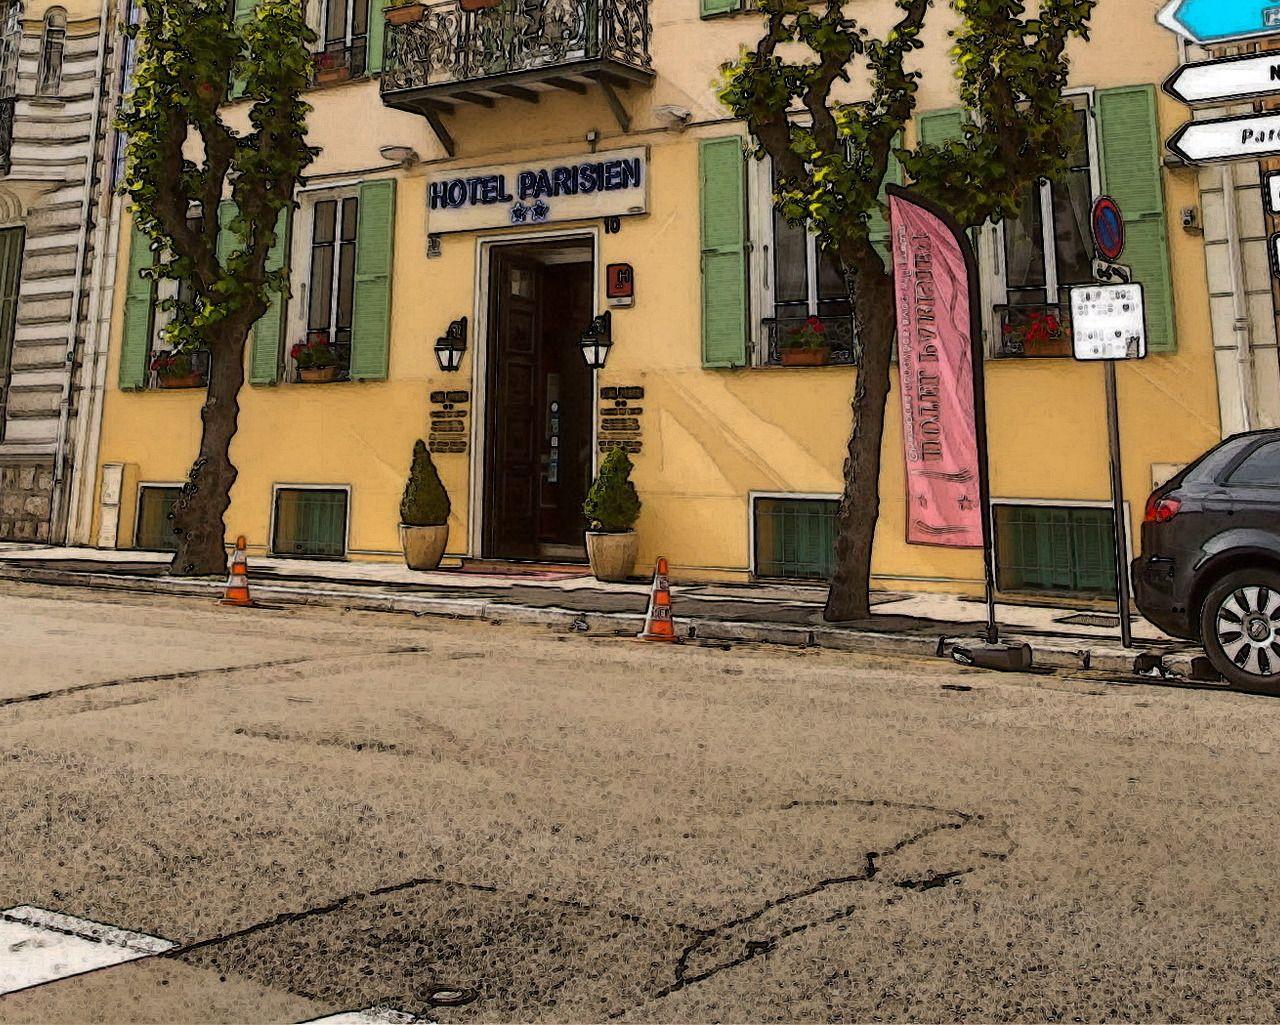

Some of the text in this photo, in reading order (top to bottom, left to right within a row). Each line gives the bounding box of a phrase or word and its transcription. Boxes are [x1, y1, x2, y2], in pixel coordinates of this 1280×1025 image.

[428, 157, 641, 210] HOTEL PARISIEN
[604, 217, 621, 234] 10
